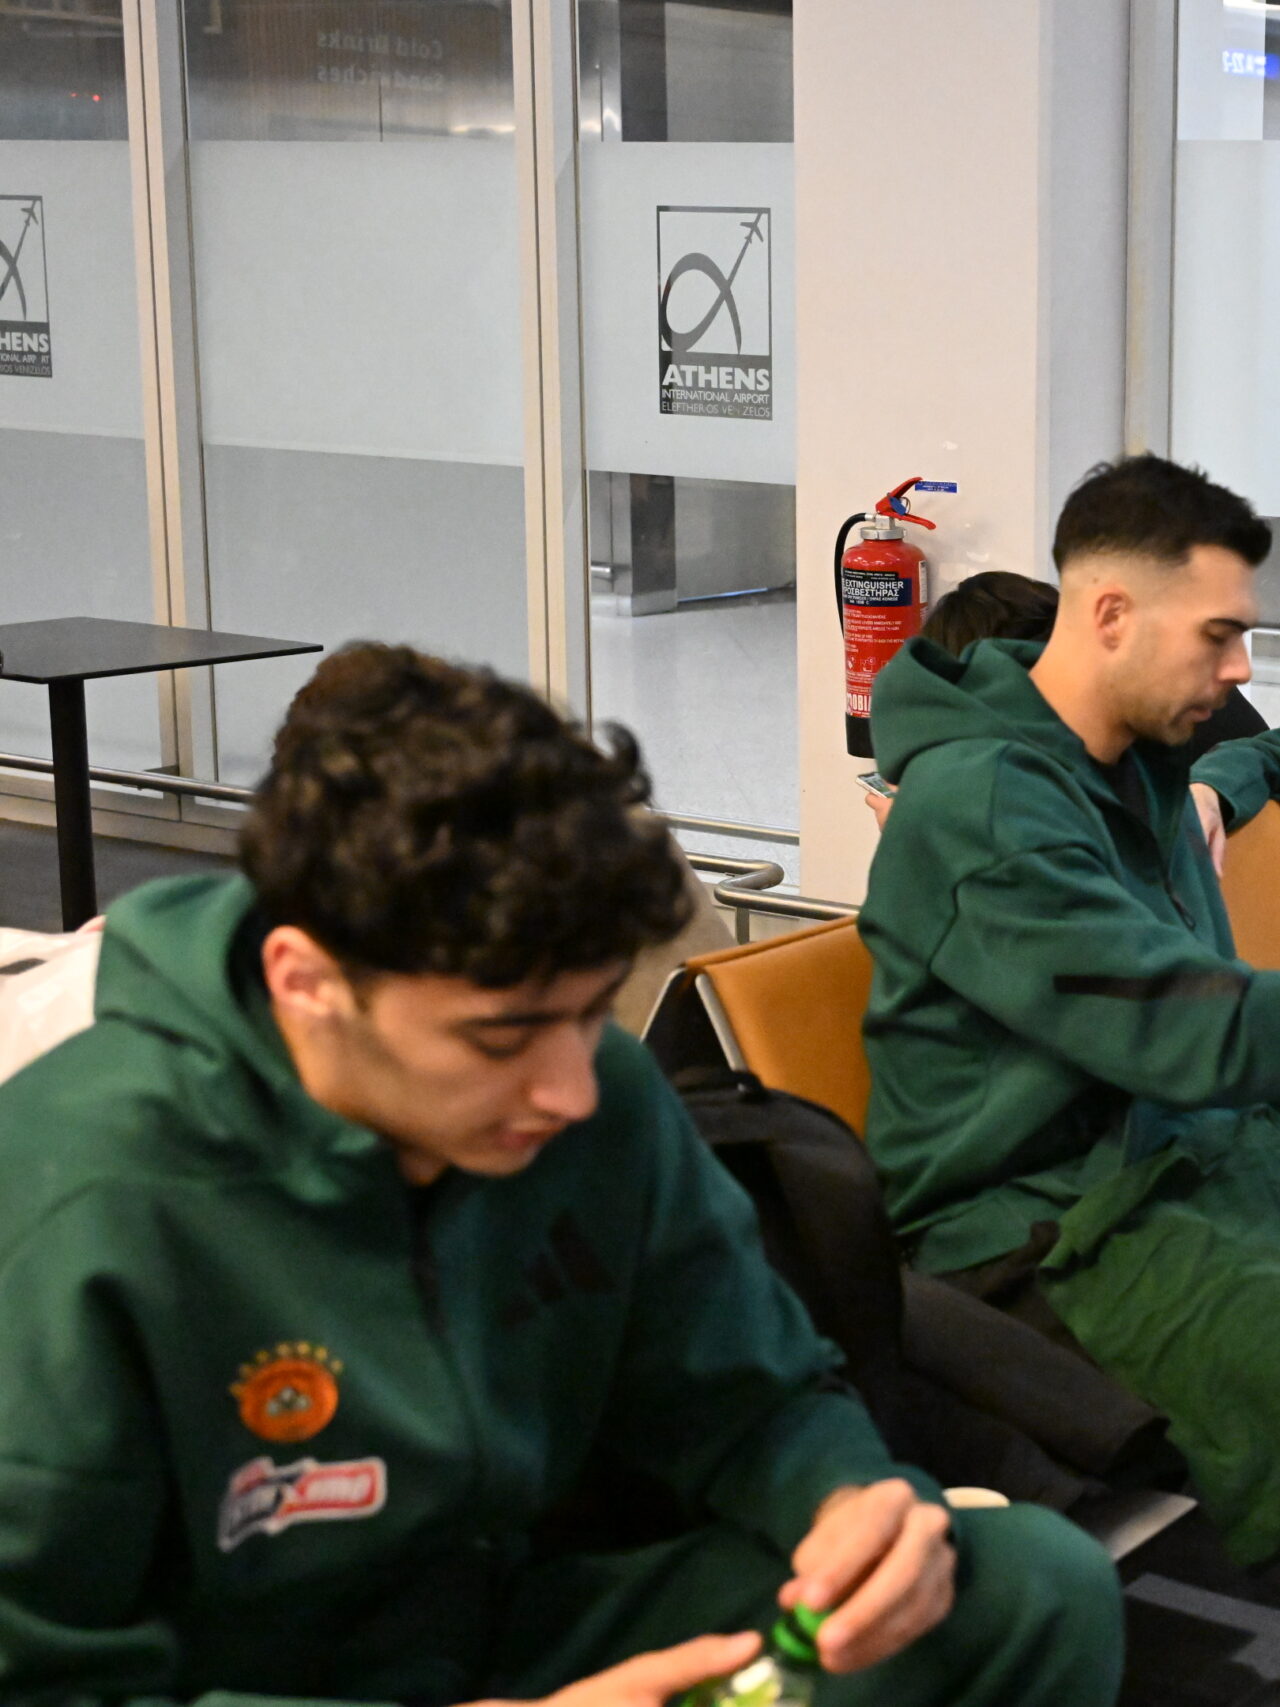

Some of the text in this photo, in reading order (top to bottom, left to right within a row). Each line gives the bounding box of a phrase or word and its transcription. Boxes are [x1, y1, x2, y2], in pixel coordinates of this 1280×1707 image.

[22, 354, 50, 365] AIRPRT
[662, 364, 770, 391] ATHENS
[661, 388, 770, 405] INTERNATIONAL AIRPORT
[661, 401, 770, 418] ELEFTHEROS VEZELOS
[845, 579, 904, 589] EXTINGUISHER
